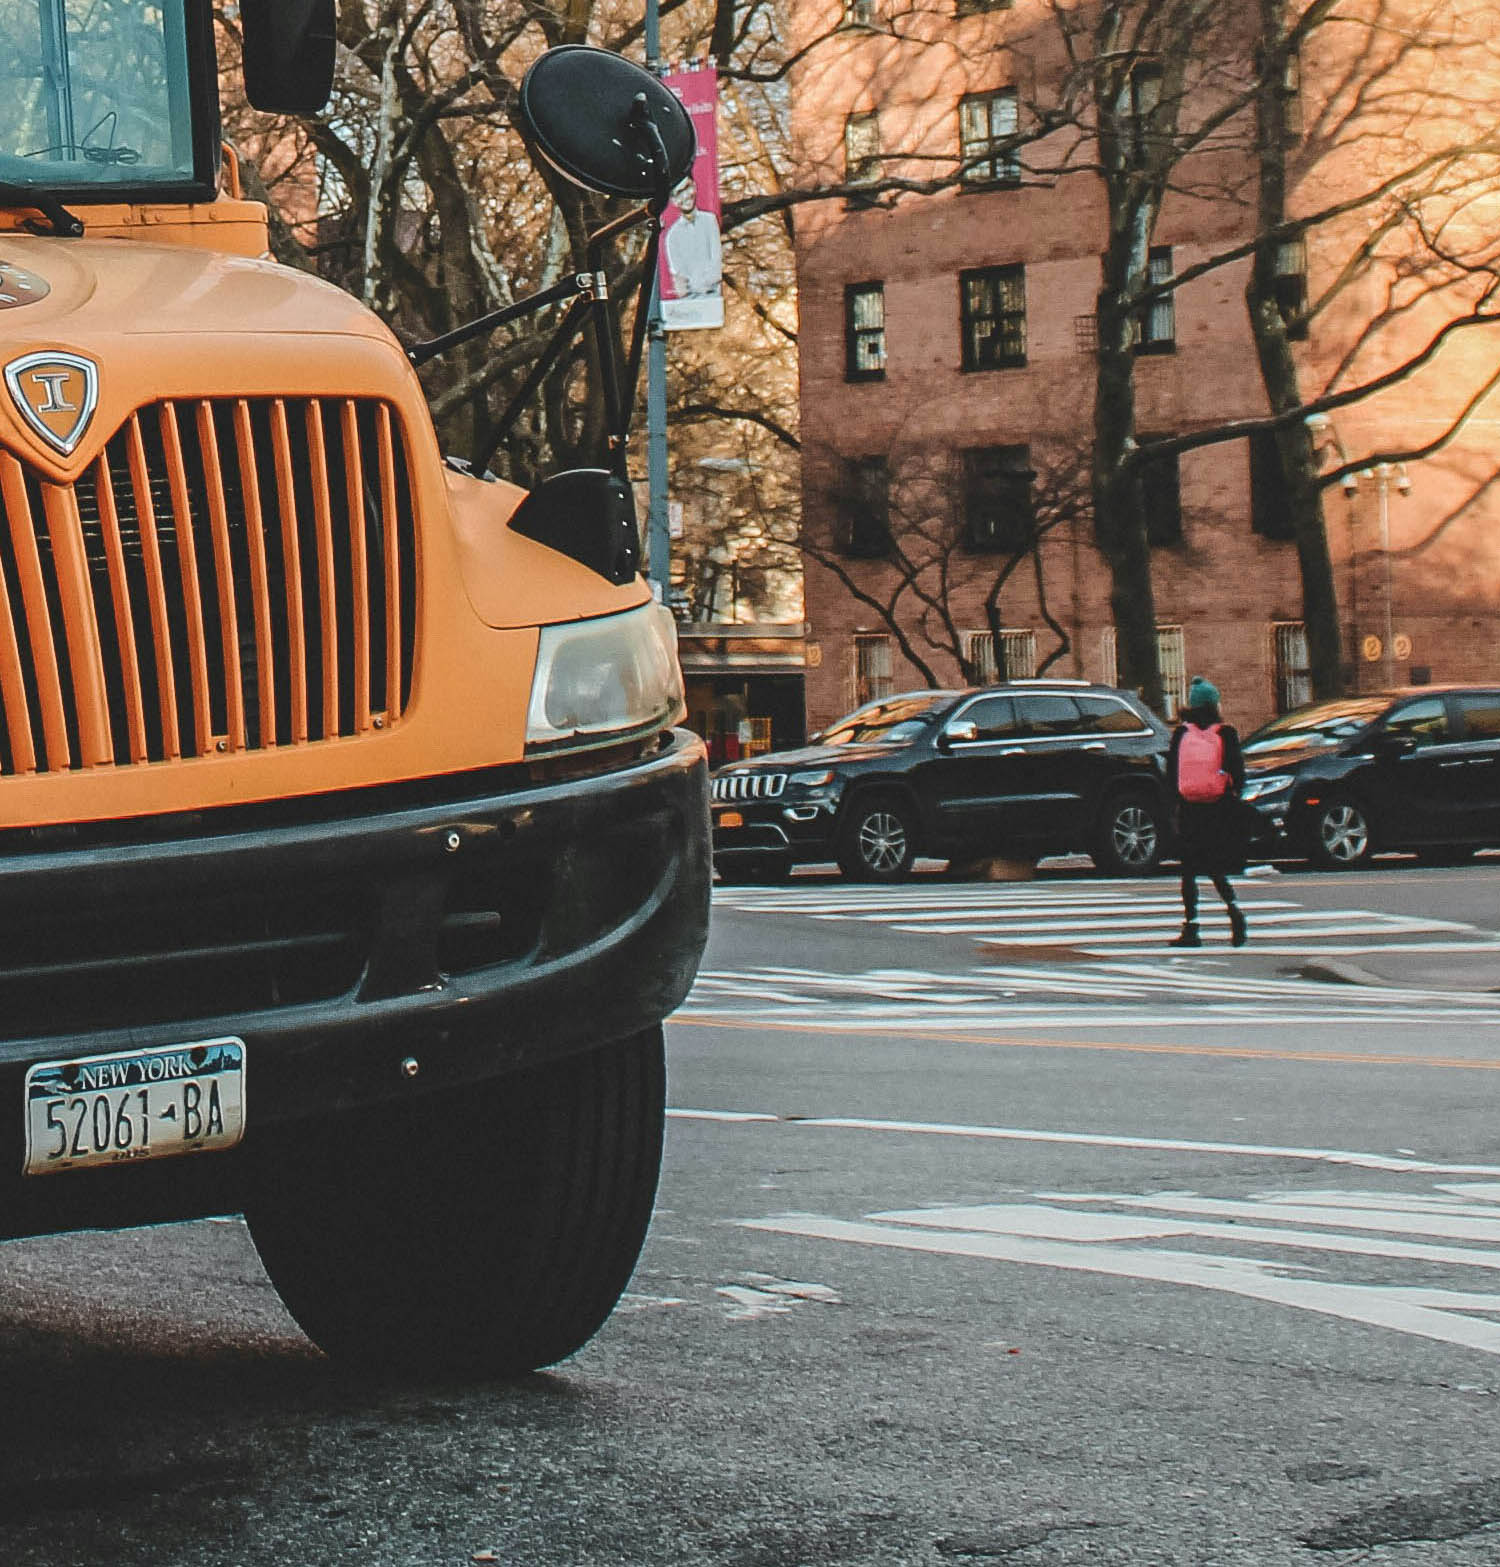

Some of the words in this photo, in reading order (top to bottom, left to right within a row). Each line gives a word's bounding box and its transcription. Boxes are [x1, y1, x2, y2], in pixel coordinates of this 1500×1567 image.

[80, 1061, 130, 1090] NEW
[135, 1053, 192, 1082] YORK
[47, 1088, 150, 1159] 52061
[182, 1078, 224, 1140] BA
